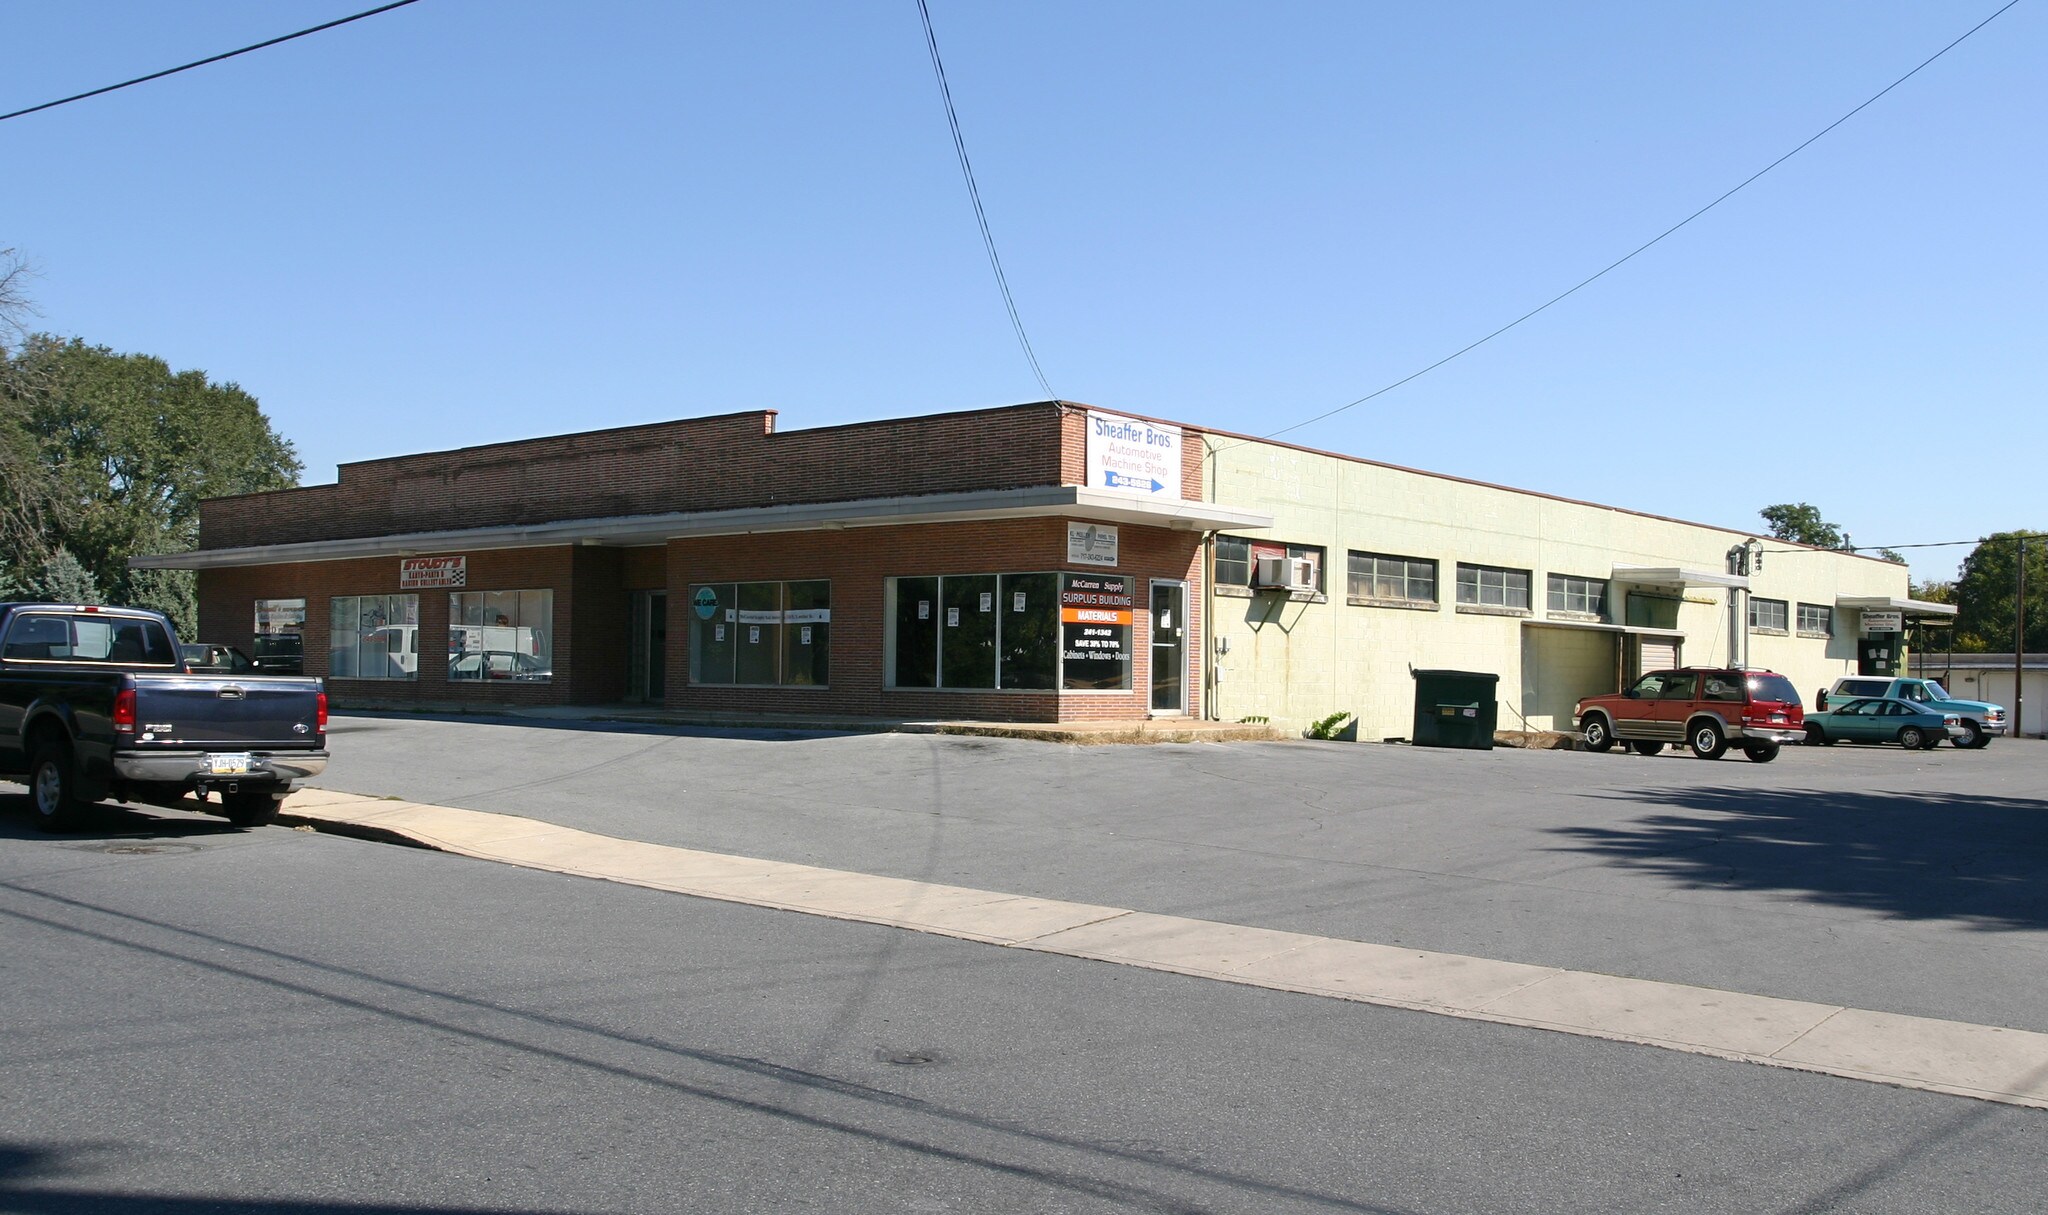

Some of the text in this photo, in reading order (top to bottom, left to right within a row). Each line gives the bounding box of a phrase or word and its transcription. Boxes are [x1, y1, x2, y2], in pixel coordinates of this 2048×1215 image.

[1096, 418, 1173, 448] Sheaffer Bros.
[1108, 441, 1162, 461] Automotive
[1101, 454, 1168, 478] Machine Shop
[403, 557, 463, 570] STOUDT'S
[1104, 581, 1124, 592] Supply
[1062, 592, 1131, 606] SURPLUS BUILDING
[1077, 610, 1118, 622] MATERIALS
[1074, 639, 1089, 648] SAVE
[1101, 640, 1109, 648] TO
[1063, 650, 1130, 661] Cabinets Windows Doors
